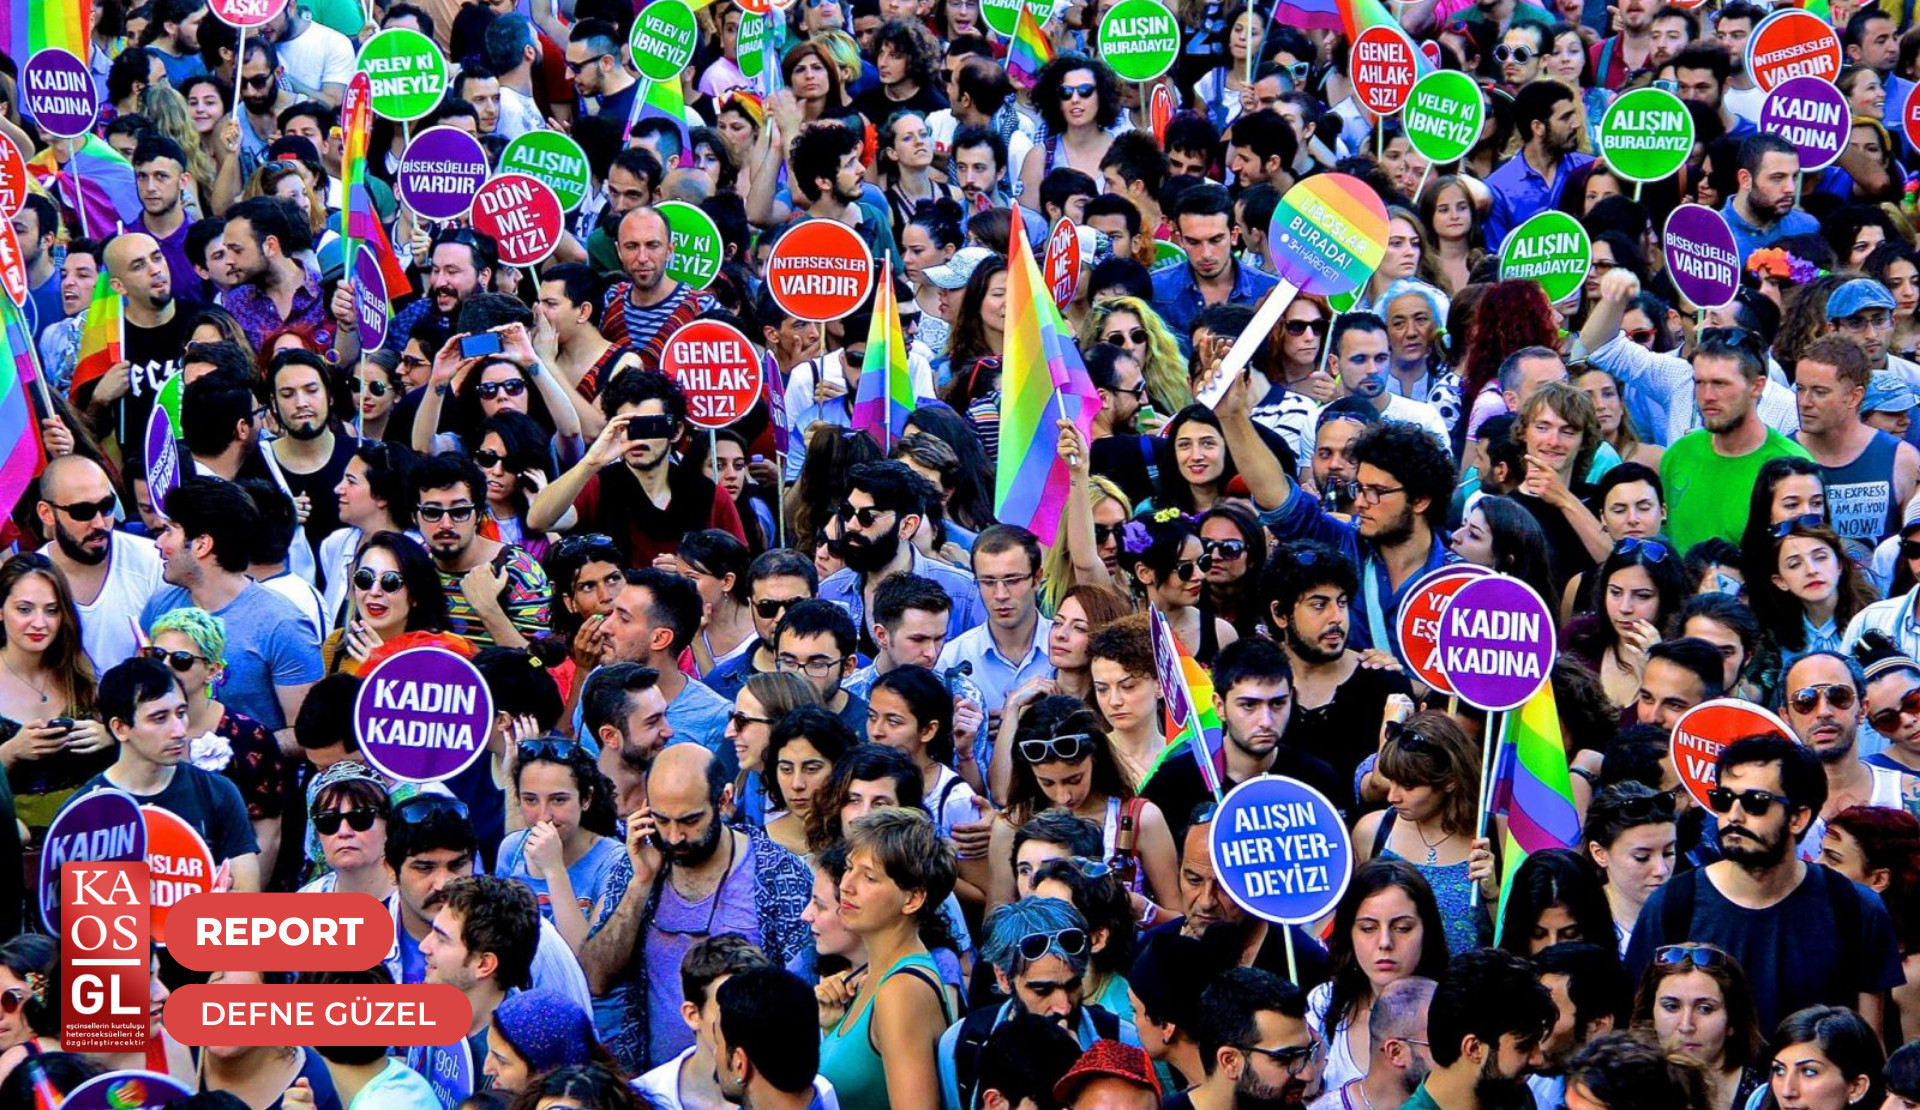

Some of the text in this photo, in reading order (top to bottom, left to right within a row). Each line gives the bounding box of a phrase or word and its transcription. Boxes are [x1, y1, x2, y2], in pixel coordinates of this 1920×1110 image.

[646, 14, 691, 45] VELEV Kİ
[1108, 16, 1169, 39] ALIŞIN
[633, 28, 687, 67] İBNEYİZ
[1103, 38, 1175, 55] BURADAYIZ
[1360, 42, 1407, 63] GENEL
[1755, 36, 1835, 67] İNTERSEKSLER
[364, 51, 435, 73] VELEV Kİ
[1359, 65, 1413, 85] AHLAK-
[1763, 53, 1834, 88] VARDIR
[29, 69, 87, 92] KADIN
[371, 72, 442, 97] BNEYİZ
[31, 95, 93, 116] KADINA
[1369, 88, 1398, 107] SIZ!
[1417, 91, 1476, 121] VELEV Kİ
[1770, 95, 1841, 126] KADIN
[1408, 107, 1473, 145] İBNEYİZ
[1611, 109, 1684, 135] ALIŞIN
[1604, 134, 1688, 151] BURADAYIZ
[402, 159, 485, 175] BİSEKSÜELLER
[511, 145, 583, 177] ALIŞIN
[409, 175, 475, 194] VARDIR
[479, 180, 540, 215] DÖN-
[494, 206, 541, 236] ME-
[500, 227, 550, 259] YİZ!
[693, 235, 711, 252] Kİ
[1512, 232, 1580, 260] ALIŞIN
[1666, 232, 1738, 268] BİSEKSÜELLER
[772, 256, 866, 272] İNTERSEKSLER
[1504, 258, 1585, 279] BURADAYIZ
[1673, 250, 1732, 287] VARDIR
[779, 274, 859, 297] VARDIR
[673, 341, 747, 364] GENEL
[676, 367, 757, 391] AHLAK-
[692, 395, 736, 417] SIZ!
[1845, 485, 1886, 499] EXPRESS
[1865, 501, 1886, 513] YOU
[1838, 518, 1879, 535] NOW!
[1451, 607, 1540, 643] KADIN
[1447, 646, 1541, 679] KADINA
[373, 678, 477, 715] KADIN
[366, 717, 475, 751] KADINA
[1235, 801, 1316, 833] ALIŞIN
[51, 821, 137, 871] KADIN
[1221, 832, 1339, 868] HER YER-
[1244, 862, 1331, 898] DEYİZ!
